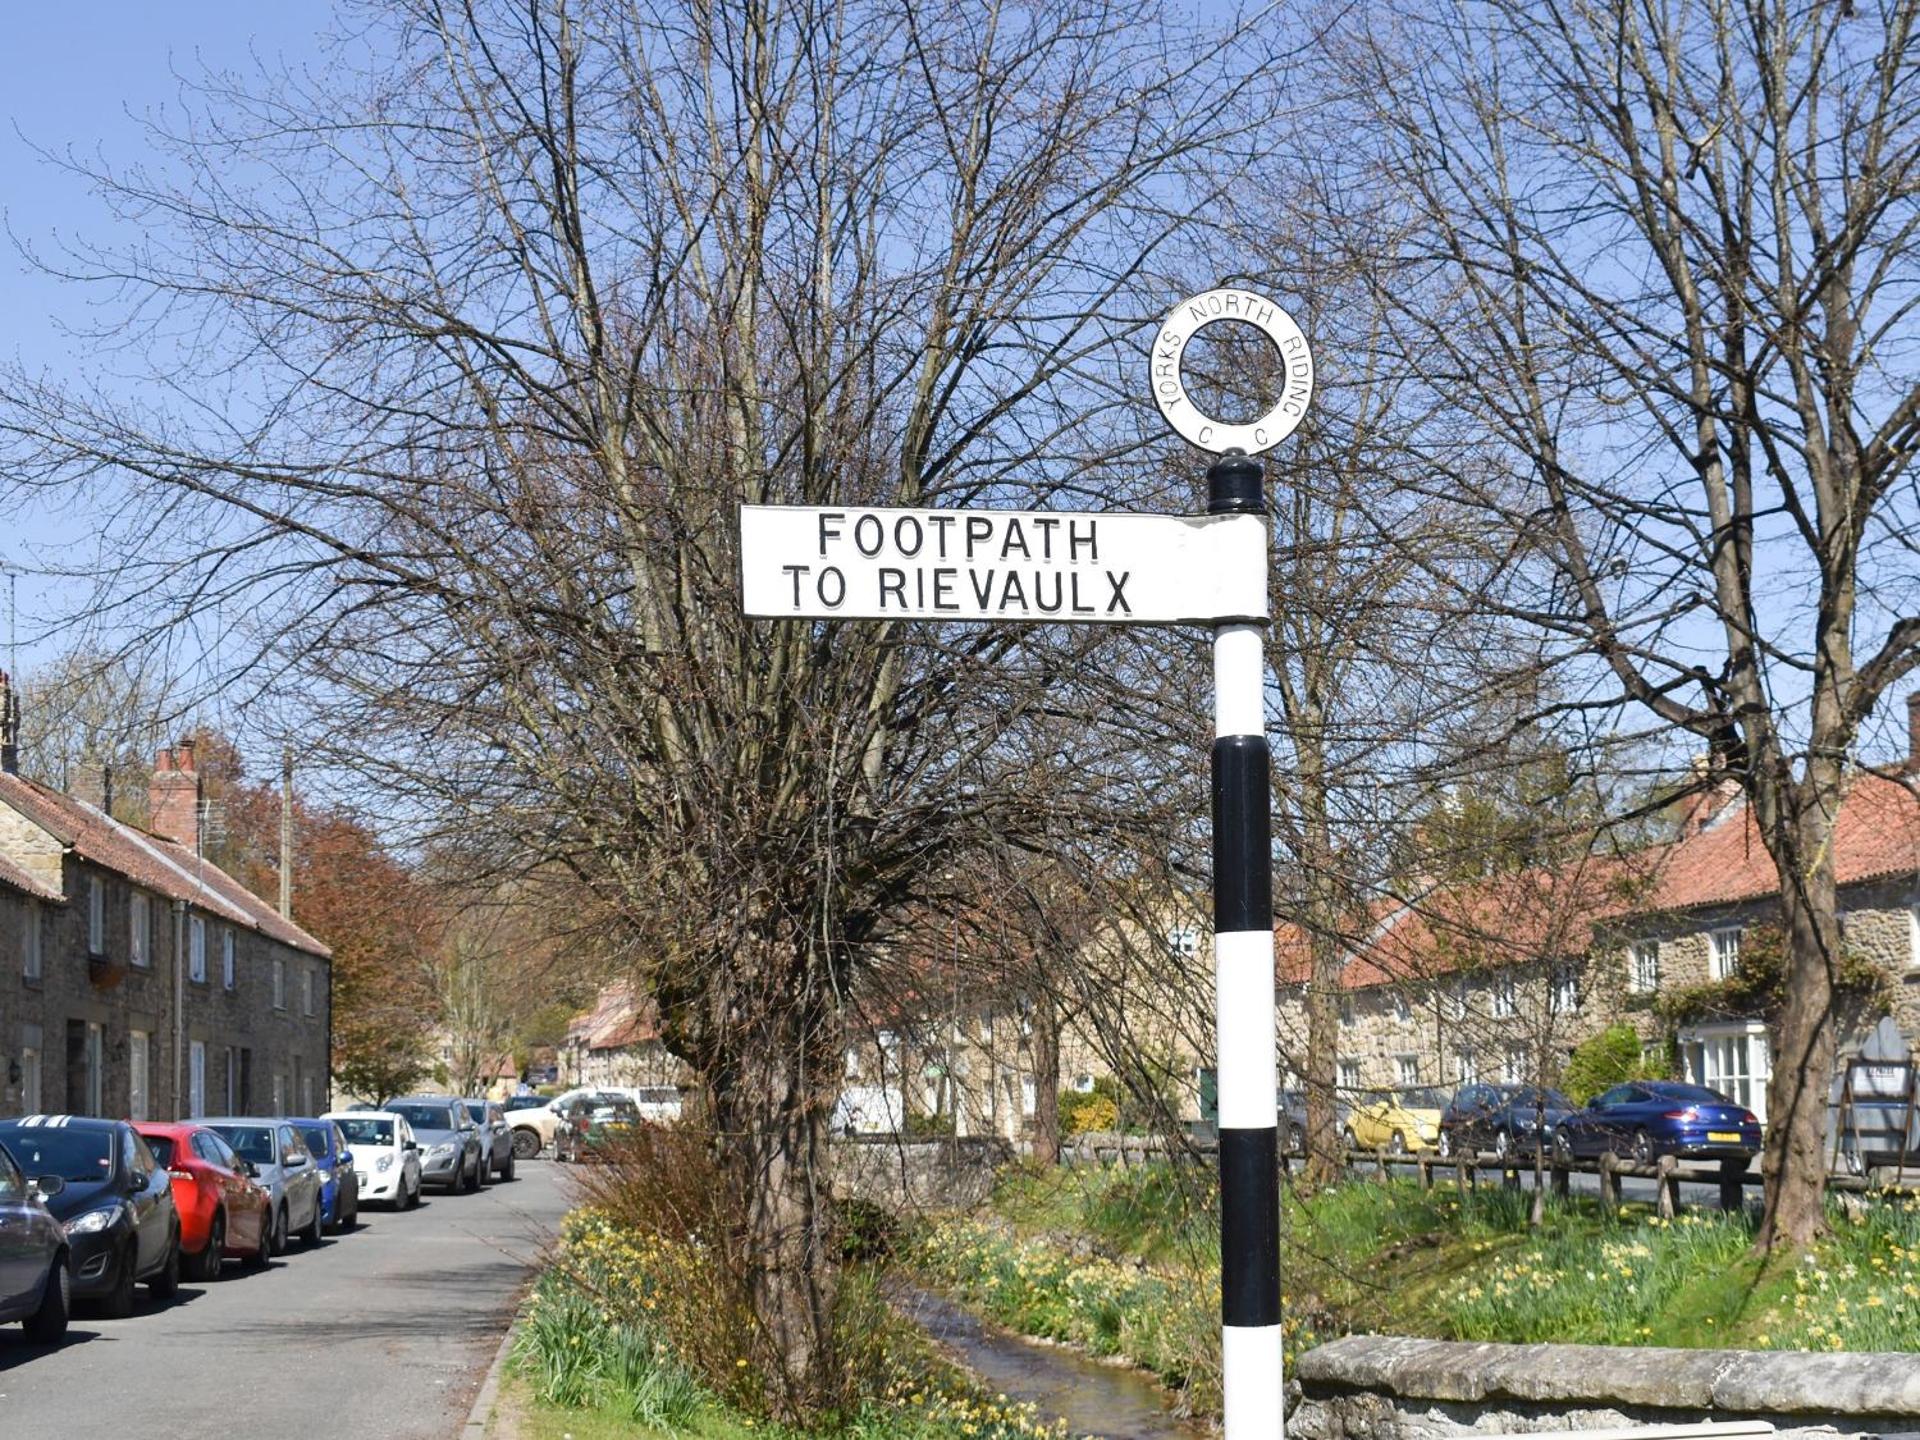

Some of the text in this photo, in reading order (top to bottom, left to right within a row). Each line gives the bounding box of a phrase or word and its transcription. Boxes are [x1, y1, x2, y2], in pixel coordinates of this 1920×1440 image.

[1155, 294, 1309, 417] YORKS NORTH RIDING
[1199, 426, 1268, 445] C C
[819, 514, 1099, 561] FOOTPATH
[782, 566, 1133, 617] TO RIEVAULX
